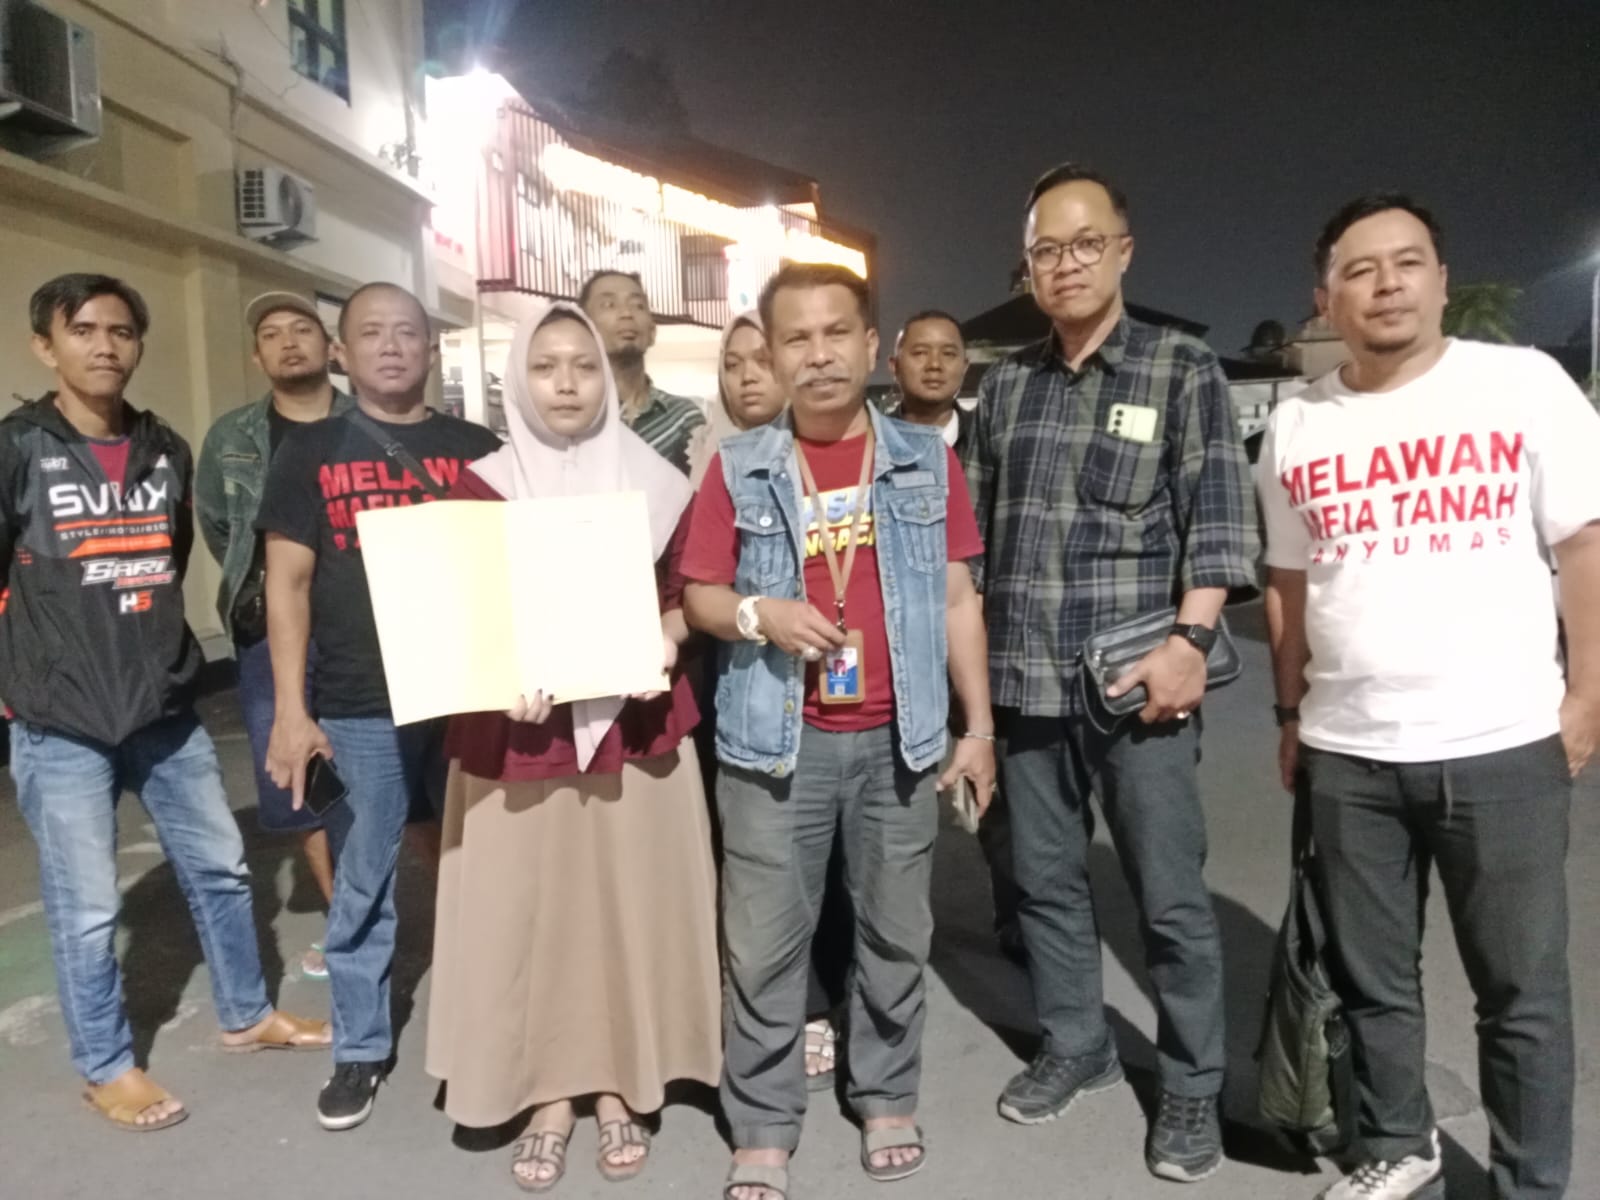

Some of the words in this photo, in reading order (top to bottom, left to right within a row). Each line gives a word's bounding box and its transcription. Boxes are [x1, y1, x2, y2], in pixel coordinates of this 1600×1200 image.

[319, 457, 473, 499] MELAW
[1281, 430, 1523, 508] MELAWAN
[1392, 483, 1518, 528] TANAH
[1313, 528, 1512, 564] ANYUMAS
